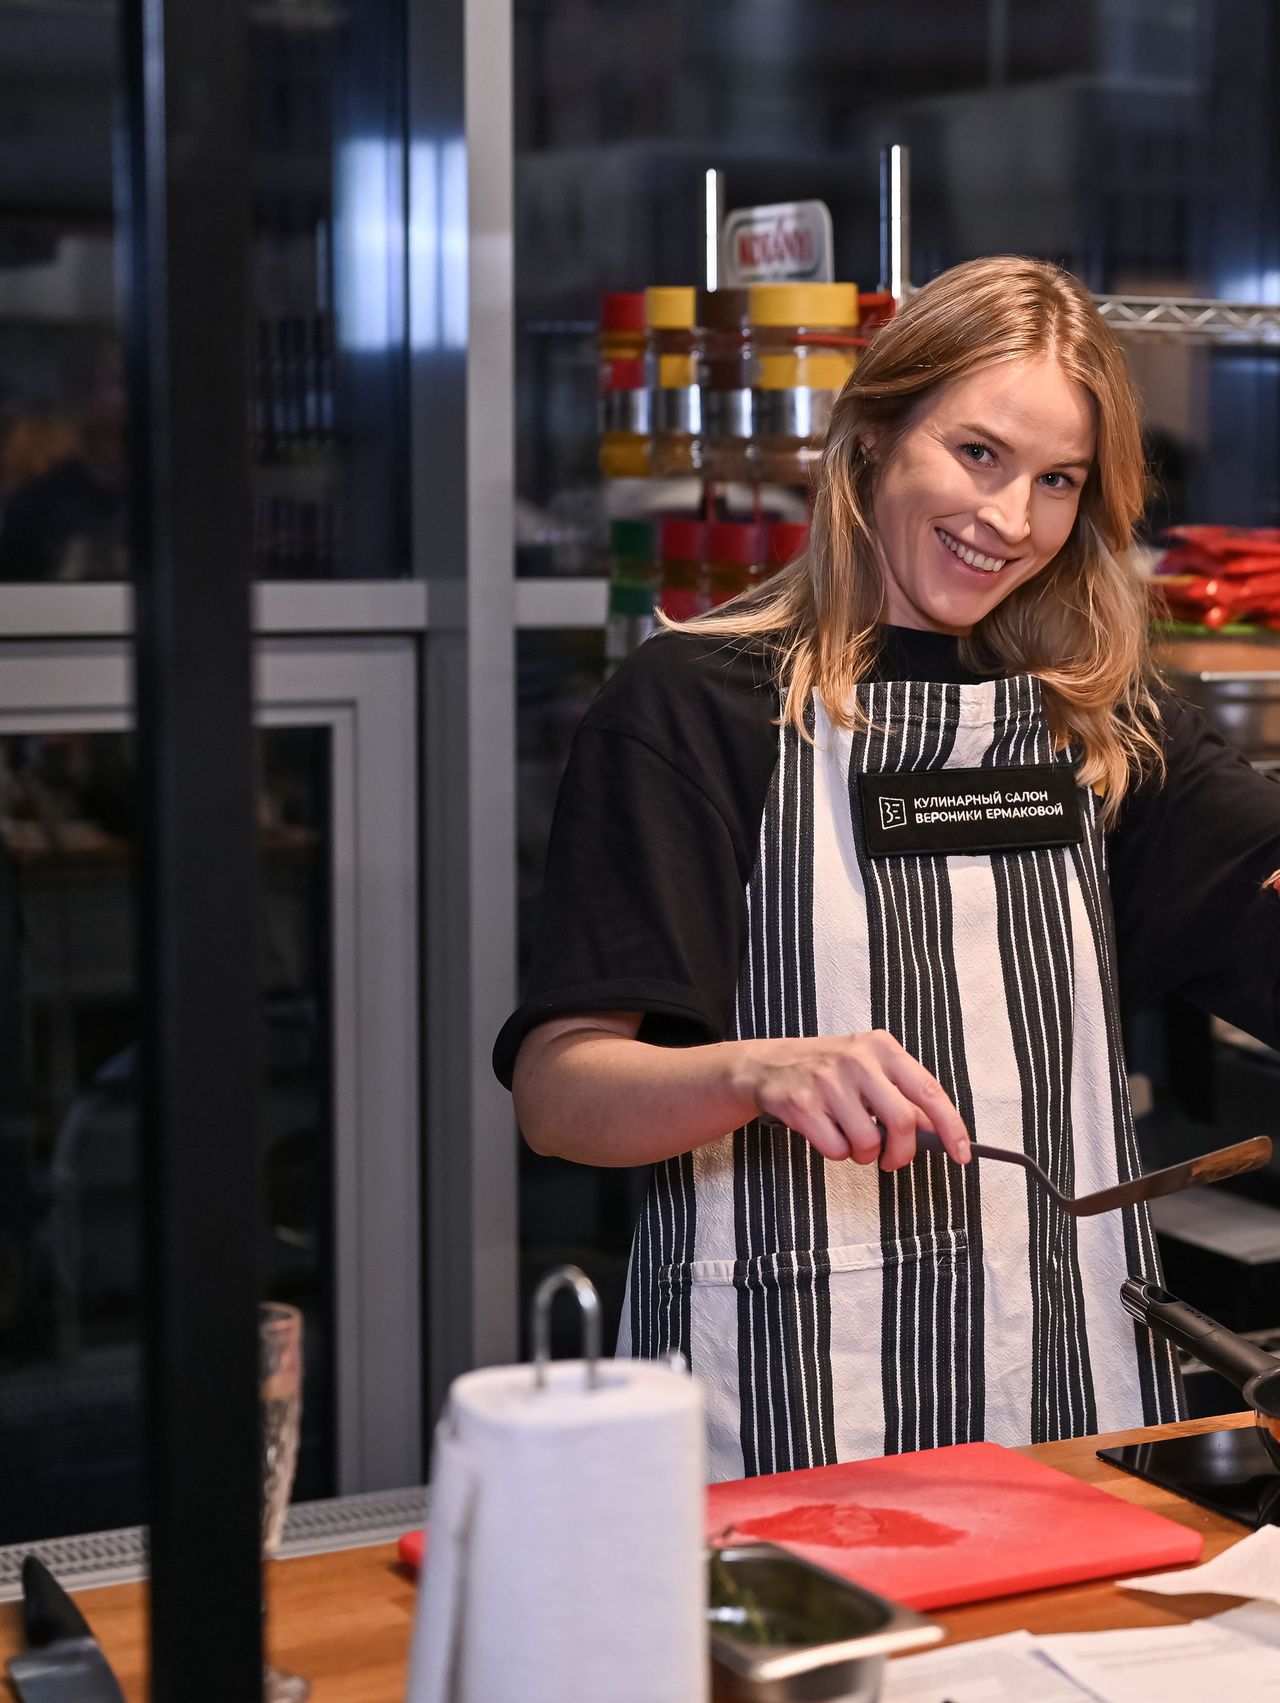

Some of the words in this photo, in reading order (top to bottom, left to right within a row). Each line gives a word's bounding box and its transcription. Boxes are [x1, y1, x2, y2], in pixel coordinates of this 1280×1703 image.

[914, 790, 1002, 809] КУЛИНАРНЫЙ
[1005, 790, 1048, 804] САЛОН
[915, 810, 982, 824] ВЕРОНИКИ
[986, 802, 1063, 820] ЕРМАКОВОЙ
